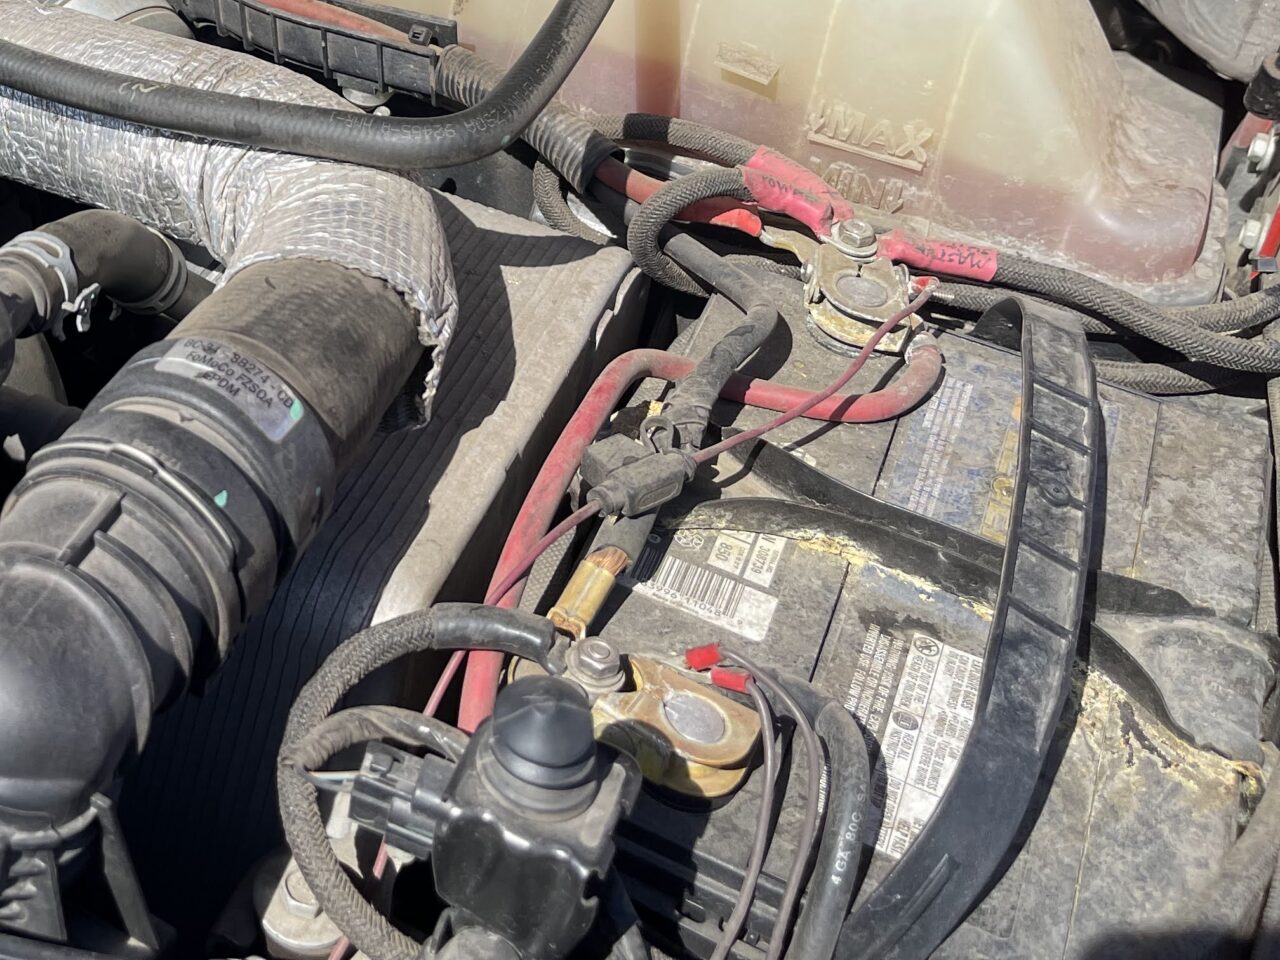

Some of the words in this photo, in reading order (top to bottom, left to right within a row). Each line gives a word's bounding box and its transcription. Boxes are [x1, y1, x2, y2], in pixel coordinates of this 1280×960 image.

[824, 100, 934, 164] MAX
[186, 351, 235, 377] FoMoCo
[714, 541, 733, 562] 850
[749, 544, 770, 575] 308739
[684, 595, 722, 617] 11048
[847, 667, 866, 697] FOLLOW
[876, 684, 890, 698] OF
[900, 731, 914, 749] READ
[896, 746, 910, 761] ALL
[832, 847, 851, 872] GA
[829, 873, 842, 885] 4
